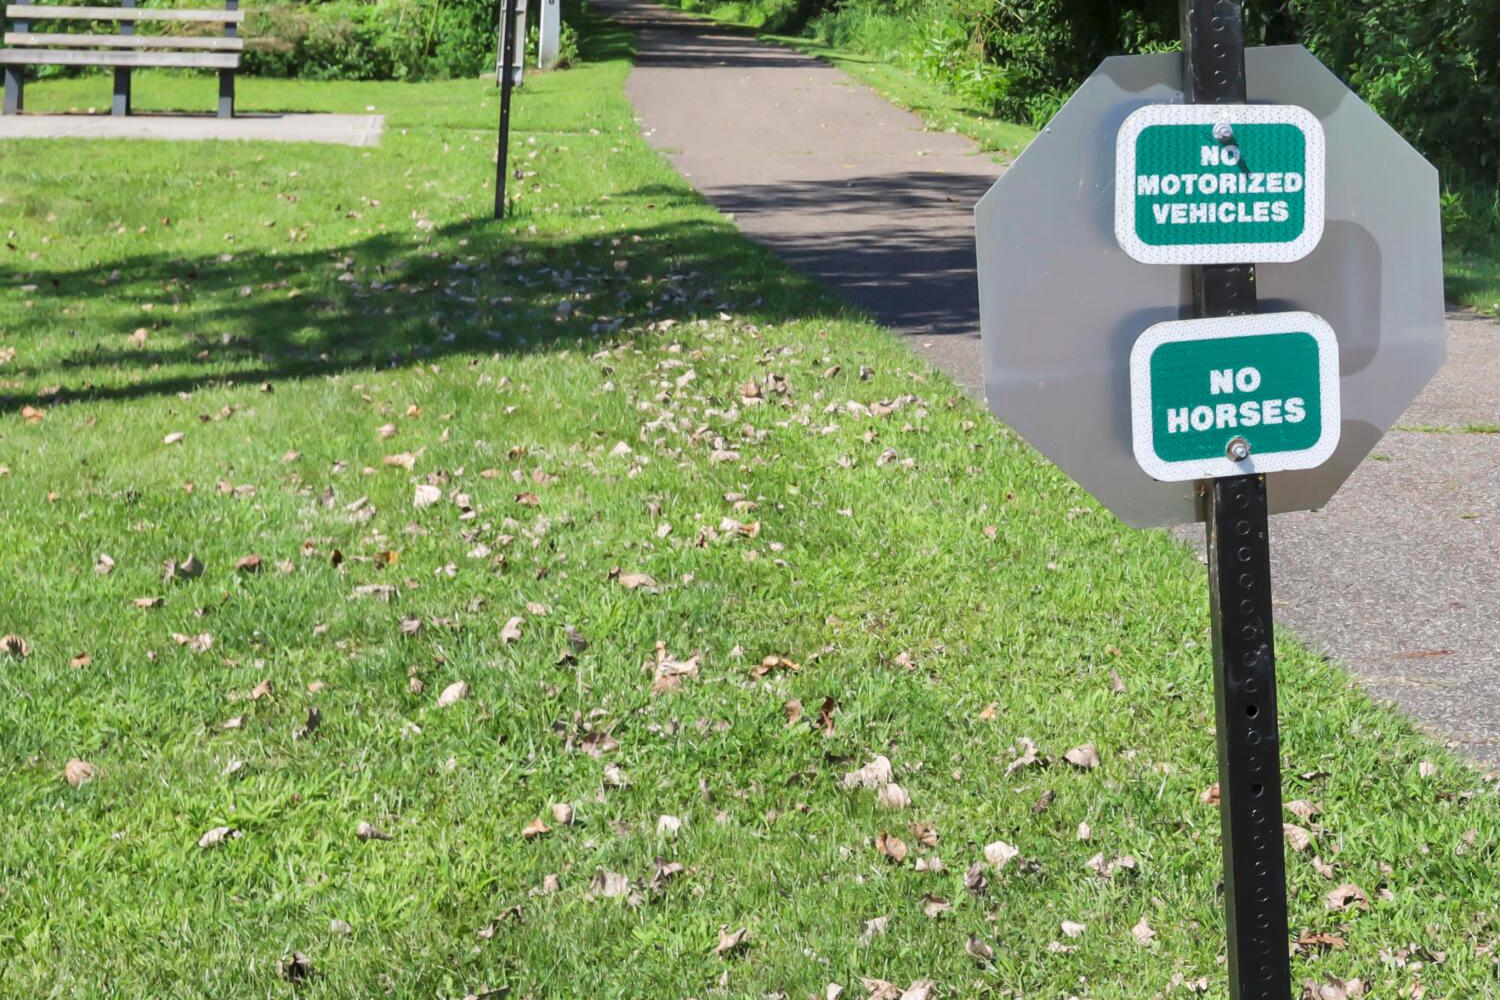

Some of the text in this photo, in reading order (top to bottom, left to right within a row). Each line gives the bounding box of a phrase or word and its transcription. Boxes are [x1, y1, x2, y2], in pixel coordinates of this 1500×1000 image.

[1200, 145, 1240, 166] NO
[1136, 172, 1303, 196] MOTORIZED
[1152, 201, 1289, 225] VEHICLES
[1209, 366, 1261, 395] NO
[1167, 397, 1306, 434] HORSES
